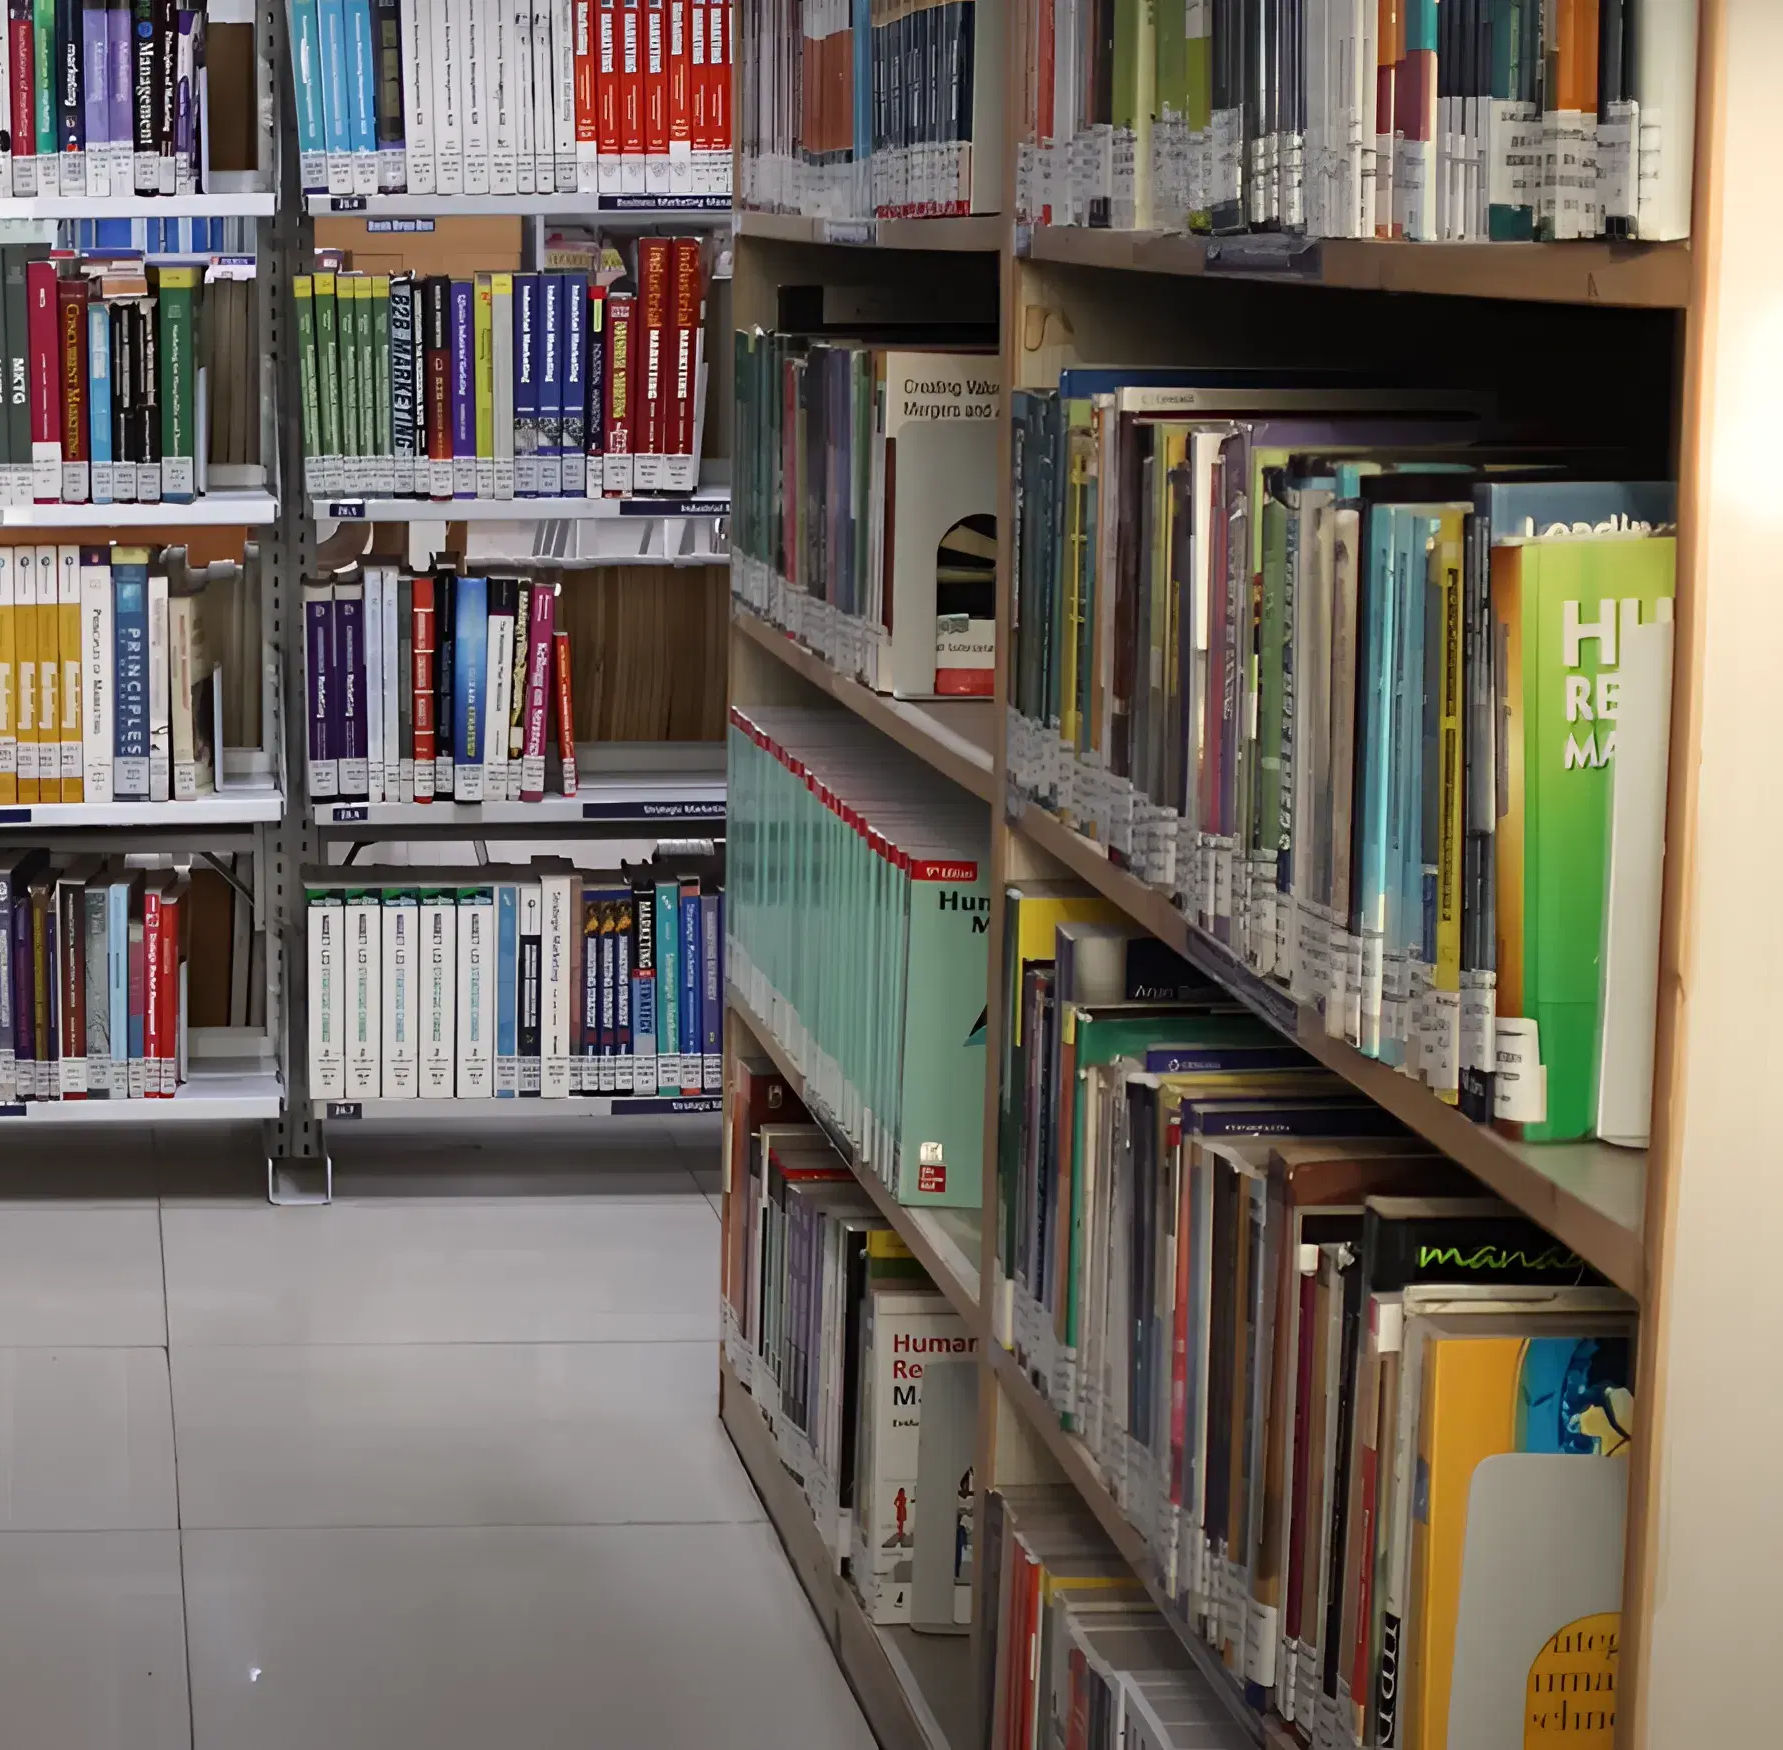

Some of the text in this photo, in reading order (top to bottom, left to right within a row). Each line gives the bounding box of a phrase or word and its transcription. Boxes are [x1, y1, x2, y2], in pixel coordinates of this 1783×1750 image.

[65, 44, 78, 106] marketing
[136, 42, 154, 144] Management
[12, 358, 25, 404] MKTG
[391, 293, 414, 448] B2B MARKETING
[126, 627, 142, 755] PRINCIPLES
[551, 892, 561, 982] Strategic Marketing
[894, 1385, 922, 1405] M
